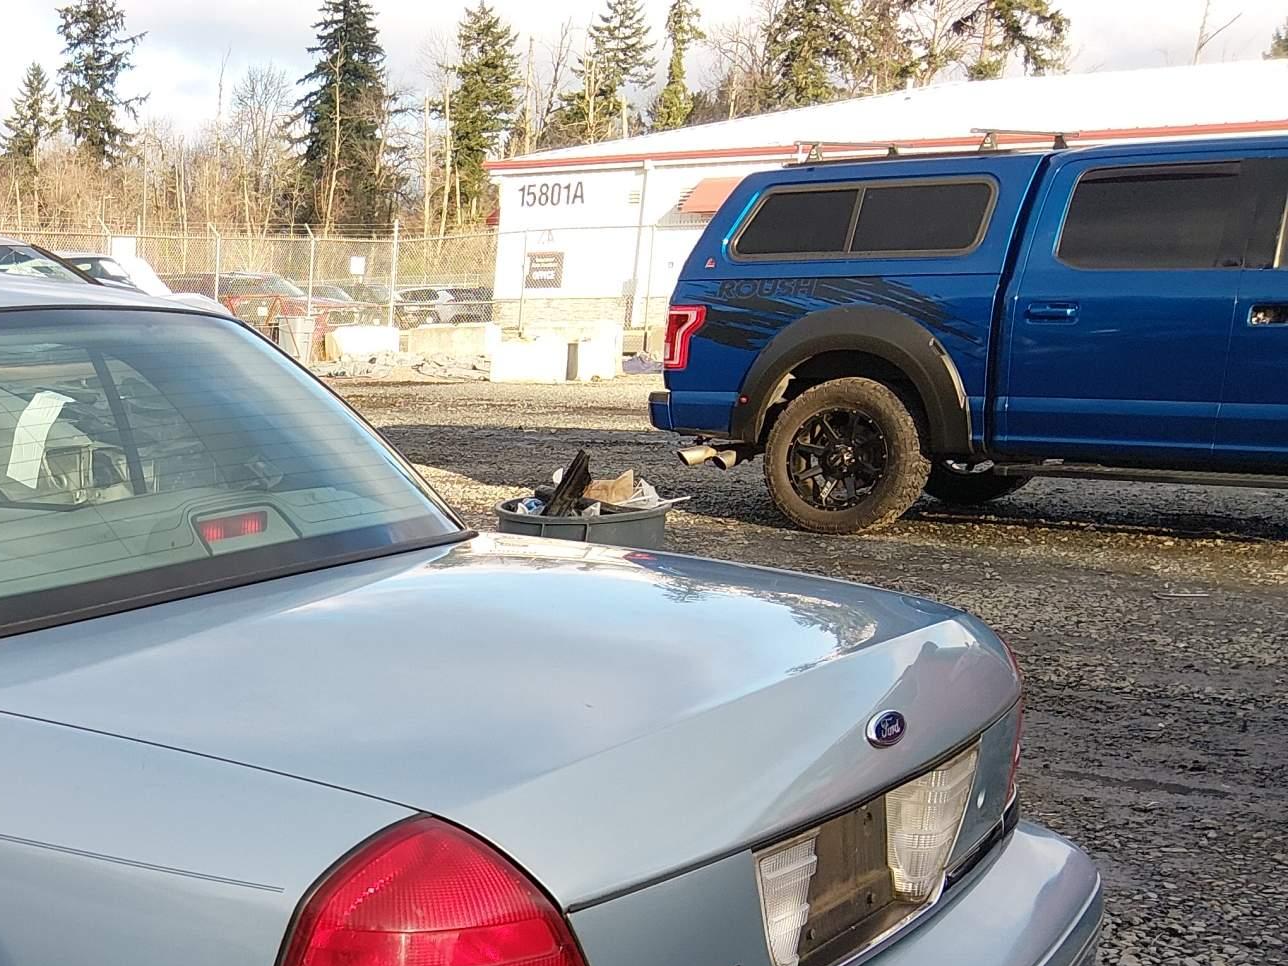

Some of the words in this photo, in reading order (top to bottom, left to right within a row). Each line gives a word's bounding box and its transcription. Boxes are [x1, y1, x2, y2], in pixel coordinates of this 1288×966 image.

[518, 181, 585, 207] 15801A
[717, 279, 817, 299] ROUSH
[880, 716, 901, 738] Ford
